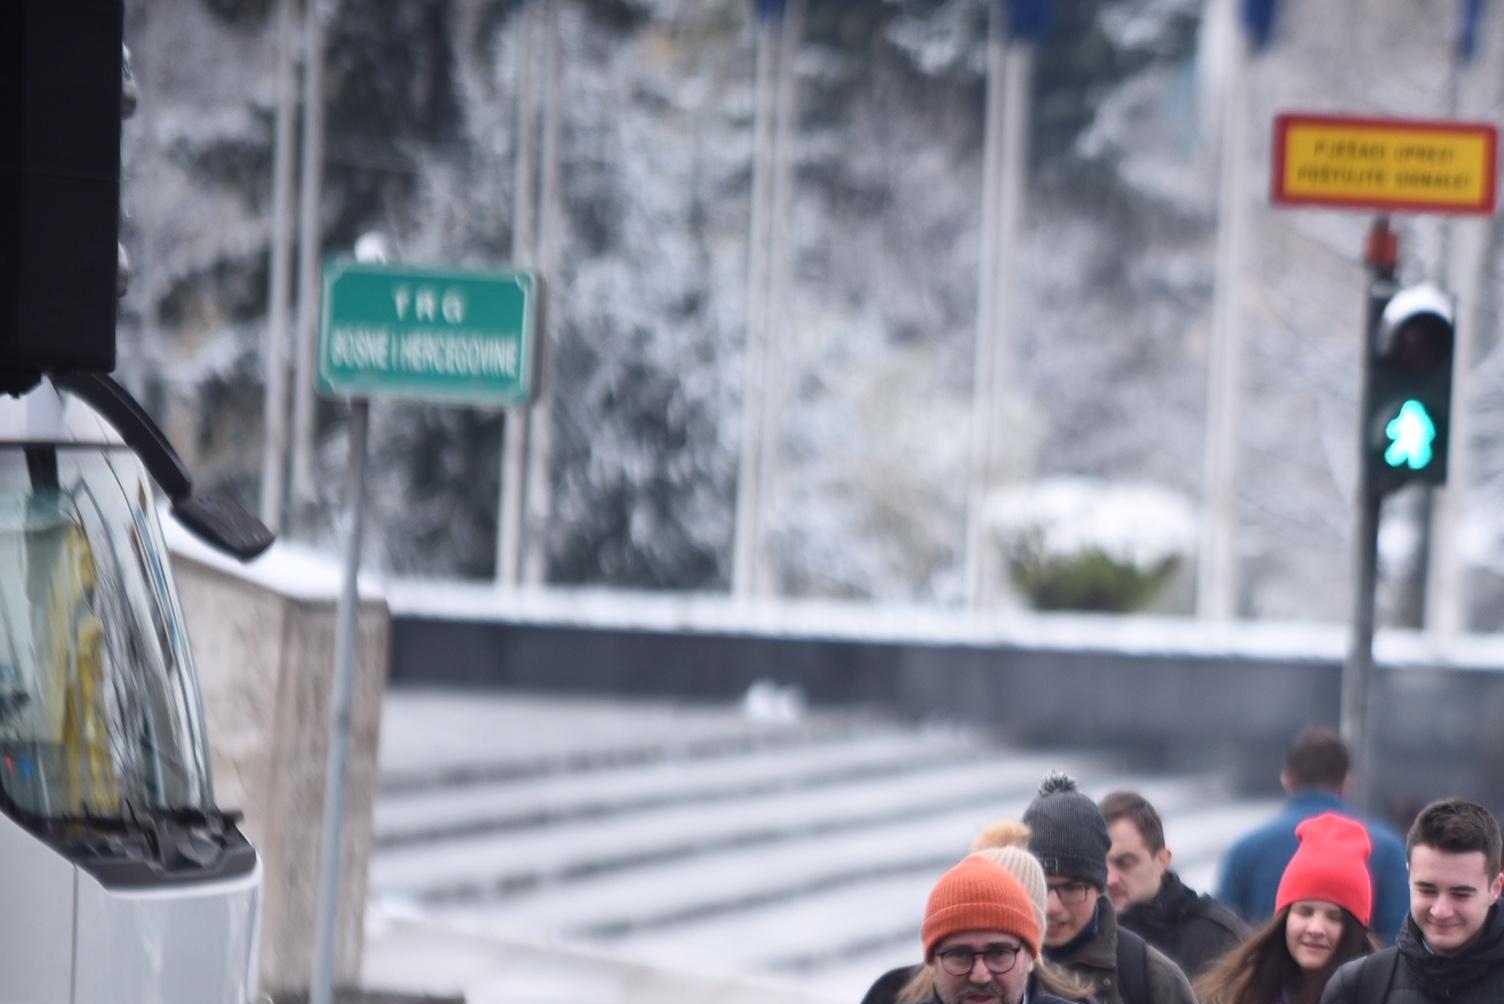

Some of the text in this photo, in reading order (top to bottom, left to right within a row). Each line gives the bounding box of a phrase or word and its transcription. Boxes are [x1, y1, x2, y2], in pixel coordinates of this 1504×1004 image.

[394, 286, 465, 324] TRG
[331, 327, 388, 370] BOSNE
[401, 332, 516, 377] HERCEGOVINE
